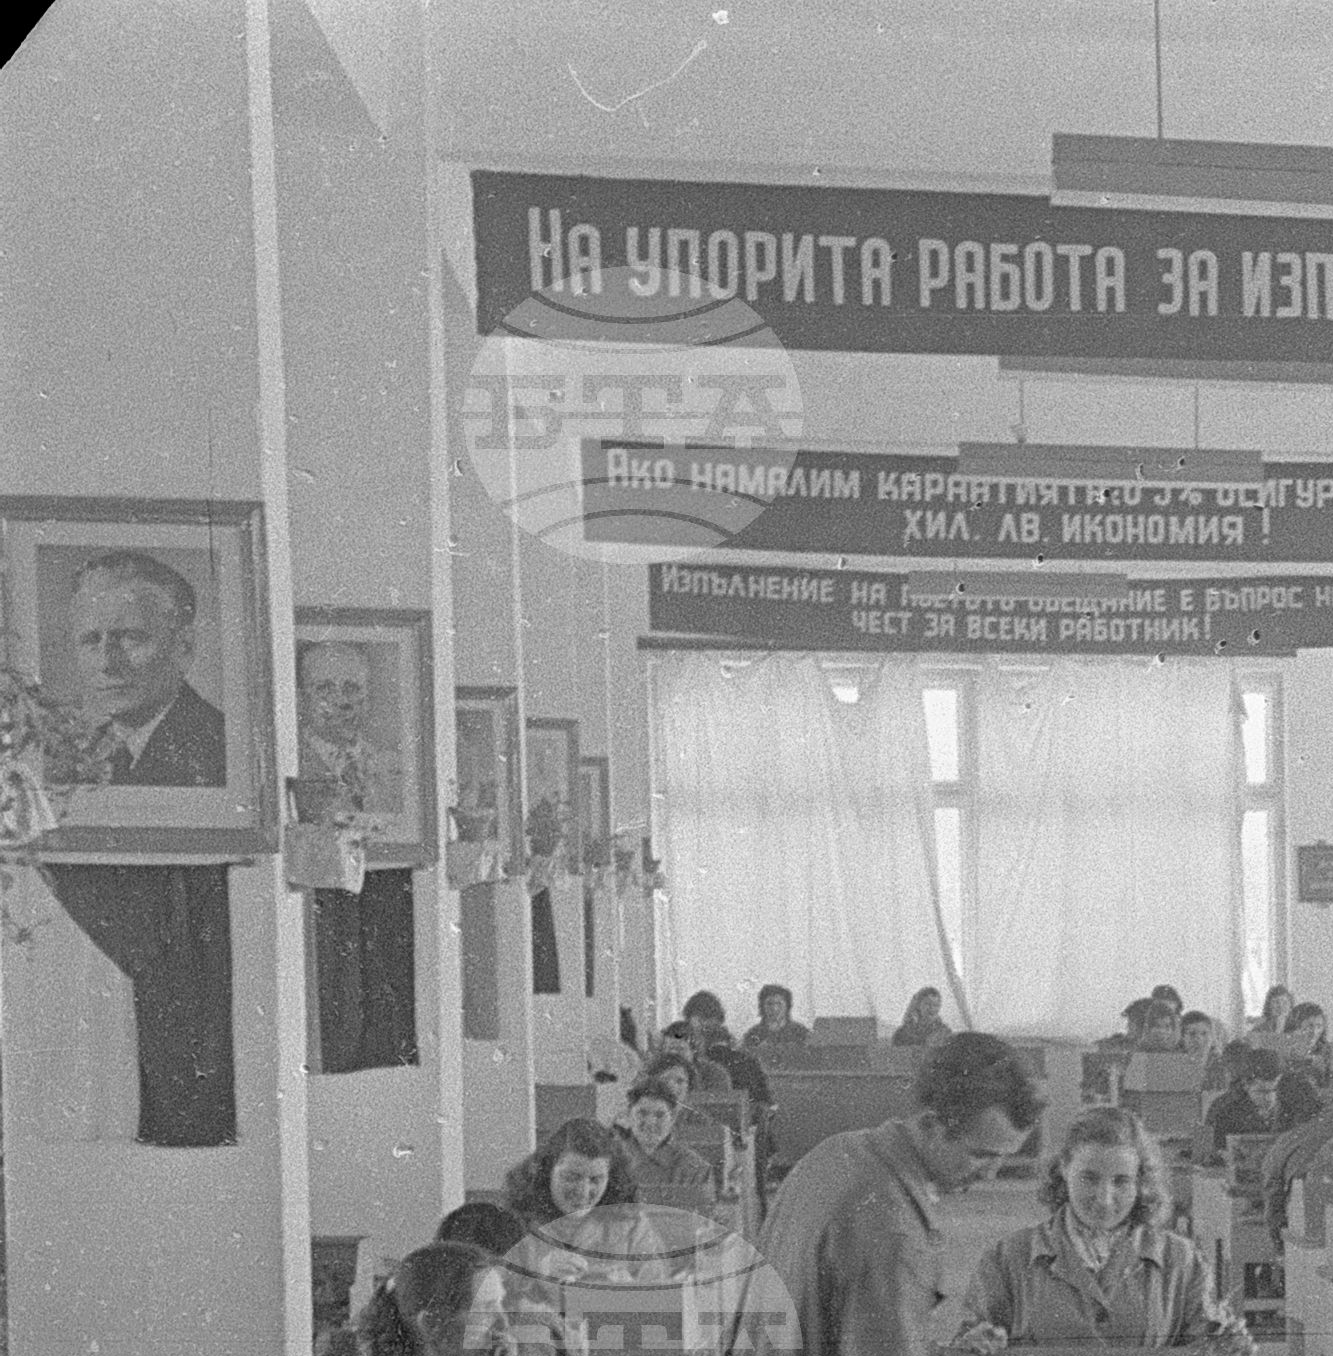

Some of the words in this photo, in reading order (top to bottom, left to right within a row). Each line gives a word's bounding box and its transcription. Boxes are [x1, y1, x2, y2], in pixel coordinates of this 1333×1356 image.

[625, 226, 892, 307] УПОРИТА
[918, 238, 1127, 314] РАБОТА
[1157, 248, 1219, 317] ЗА
[690, 463, 861, 499] НАМАЛИМ
[998, 512, 1049, 544] ЛВ.
[1061, 513, 1244, 545] ИКОНОМИЯ
[661, 563, 836, 603] ИЗПЪЛНЕНИЕ
[850, 580, 887, 606] НА
[1179, 588, 1194, 611] Е
[1205, 585, 1304, 612] ВЪПРОС
[850, 609, 913, 634] ЧЕСТ
[924, 612, 955, 637] ЗА
[967, 613, 1048, 642] ВСЕКИ
